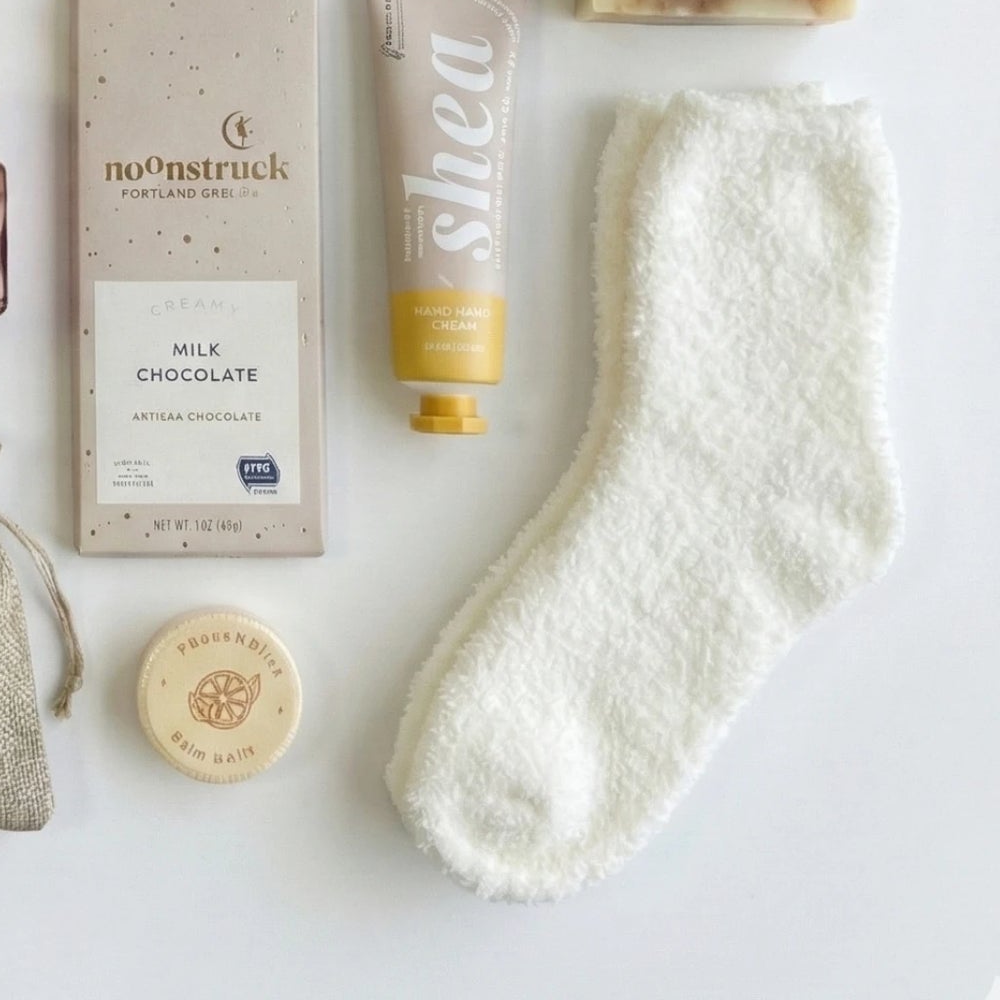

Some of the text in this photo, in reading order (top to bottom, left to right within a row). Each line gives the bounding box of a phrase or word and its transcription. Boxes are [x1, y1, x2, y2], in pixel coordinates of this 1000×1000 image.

[402, 32, 494, 263] shea
[173, 343, 220, 357] MILK
[136, 368, 258, 382] CHOCOLATE
[188, 412, 262, 422] CHOCOLATE
[153, 519, 171, 531] NET
[174, 519, 192, 531] WT.
[170, 730, 206, 761] Balm
